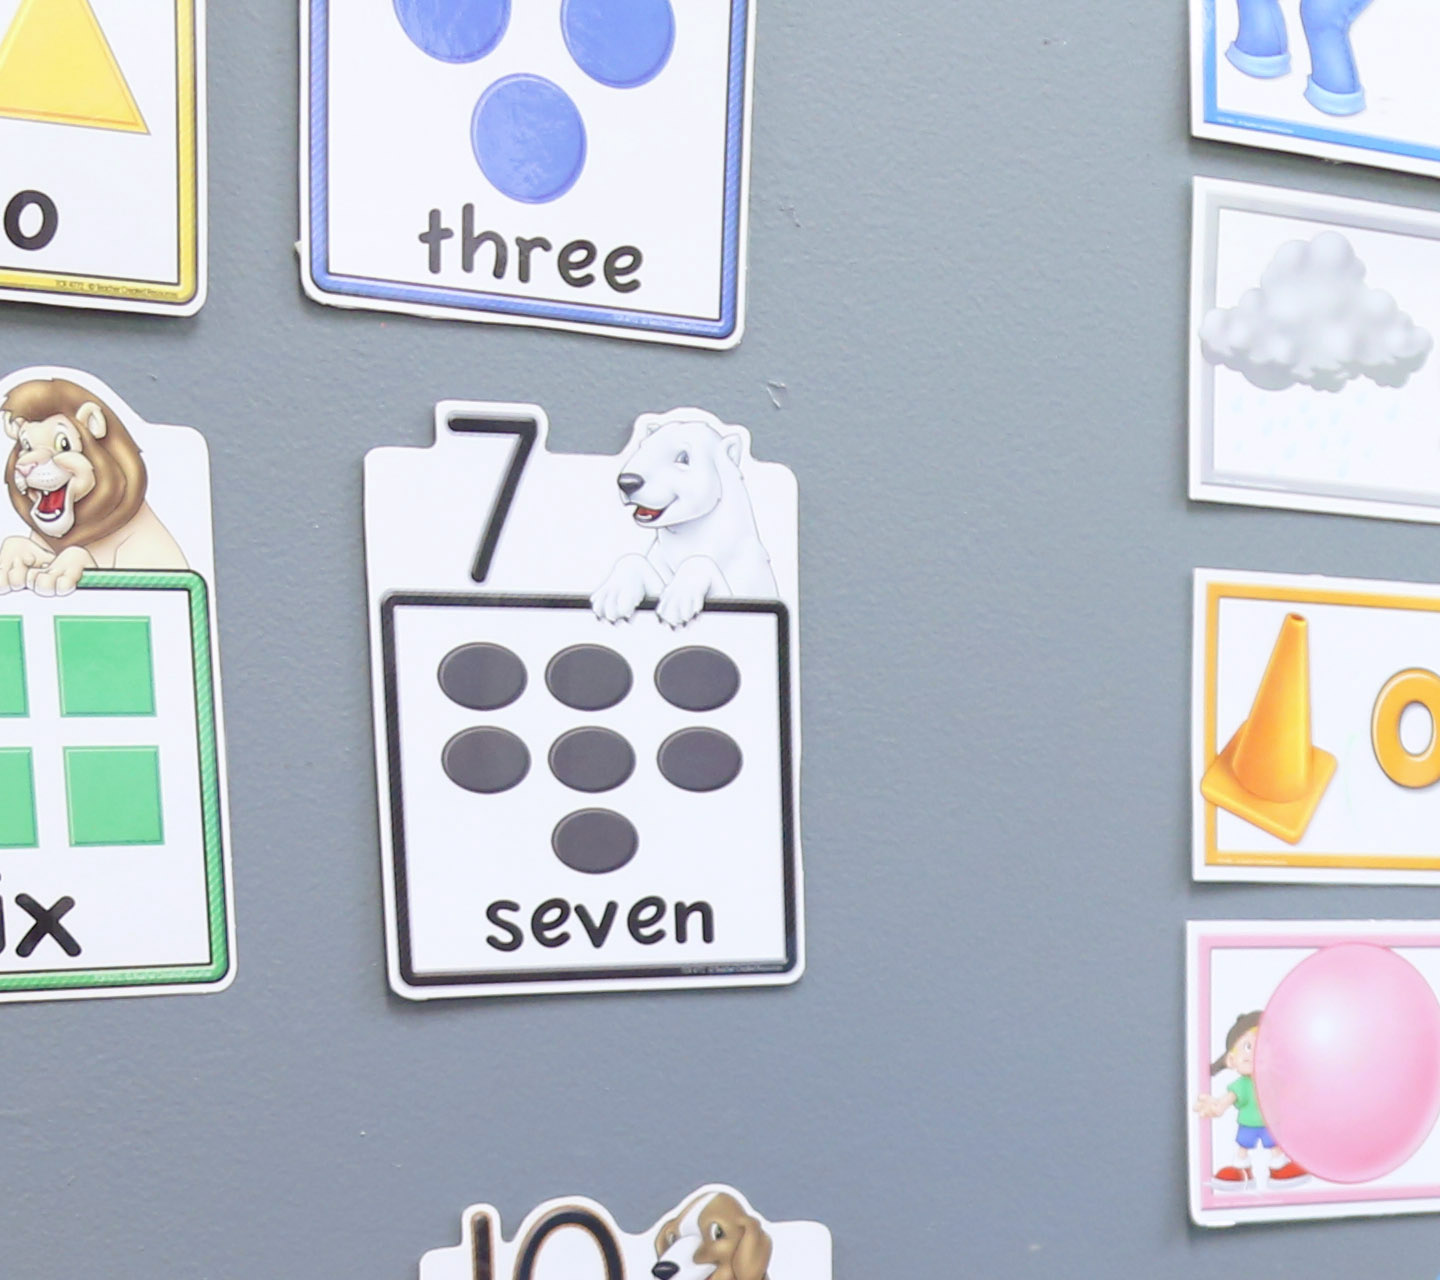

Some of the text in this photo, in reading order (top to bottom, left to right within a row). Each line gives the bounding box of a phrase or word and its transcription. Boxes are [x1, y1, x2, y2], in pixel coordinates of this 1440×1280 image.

[417, 203, 643, 294] three
[445, 413, 538, 583] 7
[485, 893, 716, 950] seven
